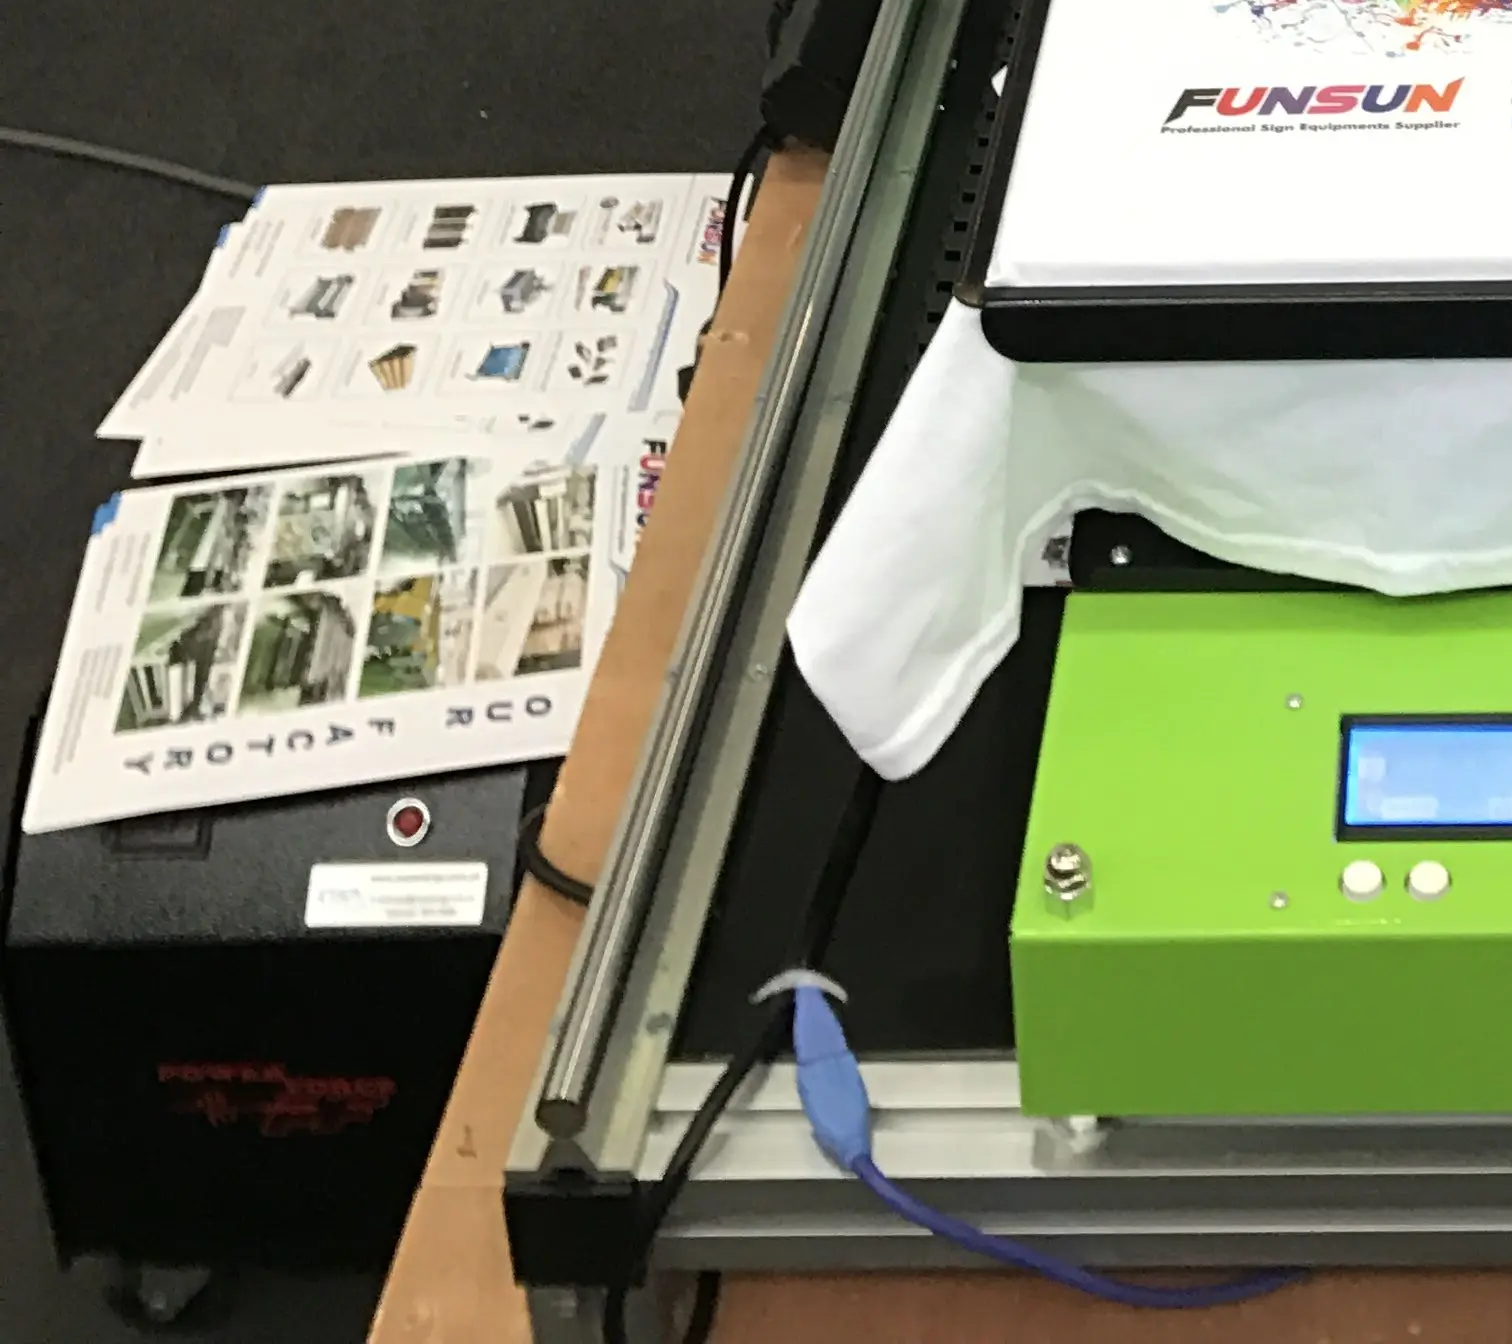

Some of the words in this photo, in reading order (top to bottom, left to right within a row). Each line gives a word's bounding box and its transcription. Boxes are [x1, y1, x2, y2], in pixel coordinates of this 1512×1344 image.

[1163, 76, 1466, 126] FUNSUN
[1160, 123, 1256, 134] Professional
[1260, 123, 1295, 134] Sign
[1299, 121, 1391, 132] Equipments
[1395, 120, 1462, 131] Supplier
[445, 694, 552, 729] OUR
[123, 717, 396, 775] FACTORY
